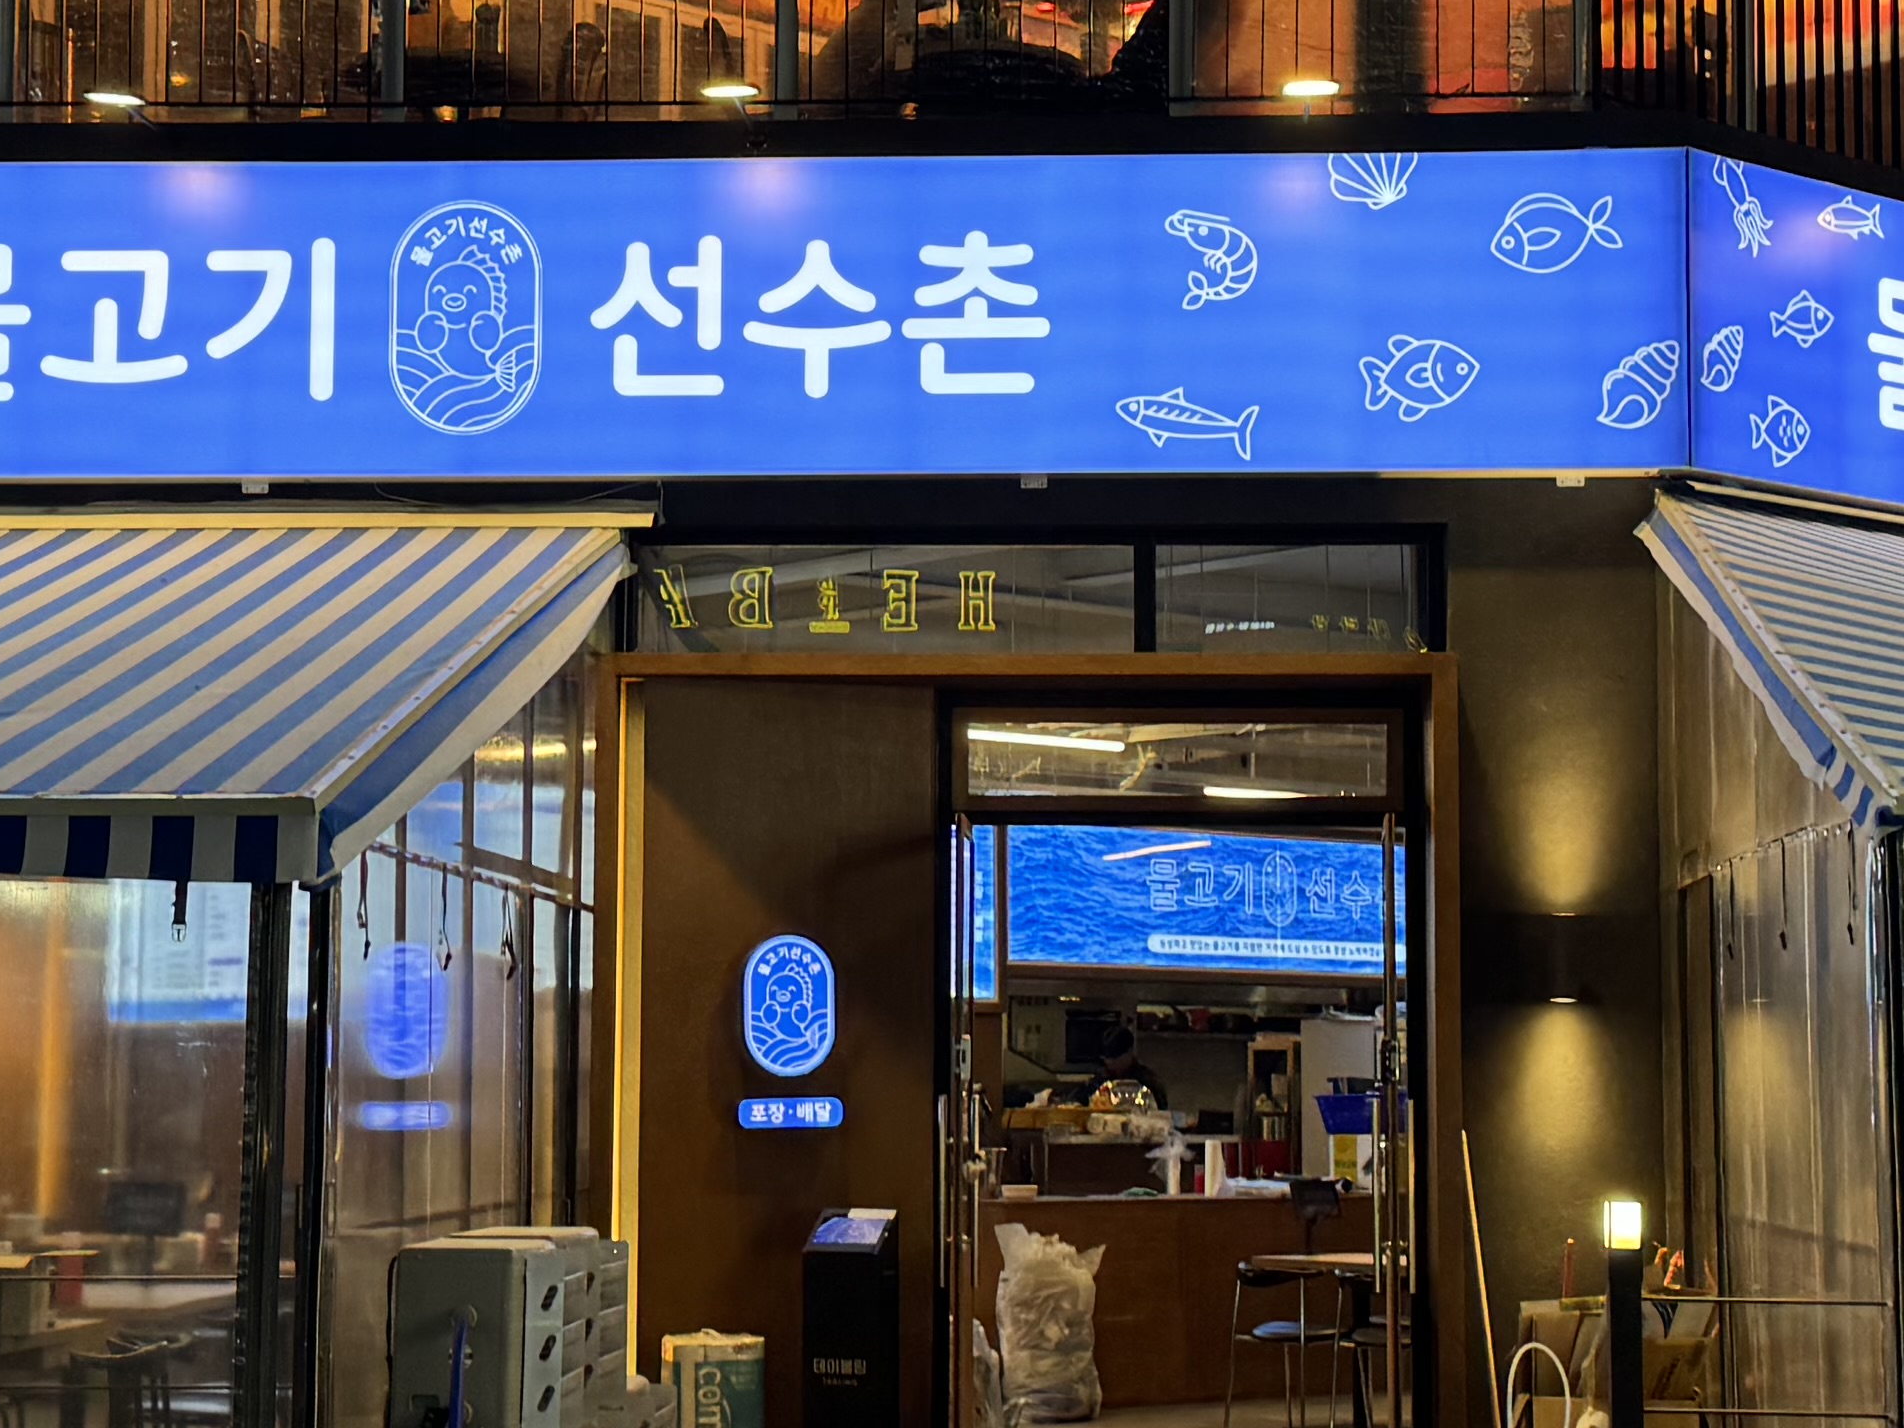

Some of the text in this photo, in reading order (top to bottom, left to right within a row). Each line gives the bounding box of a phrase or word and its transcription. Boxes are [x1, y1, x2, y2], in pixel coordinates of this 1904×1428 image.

[410, 216, 523, 266] 물고기선수촌
[589, 230, 1052, 400] 선수촌
[1145, 857, 1384, 921] 물고기 선수
